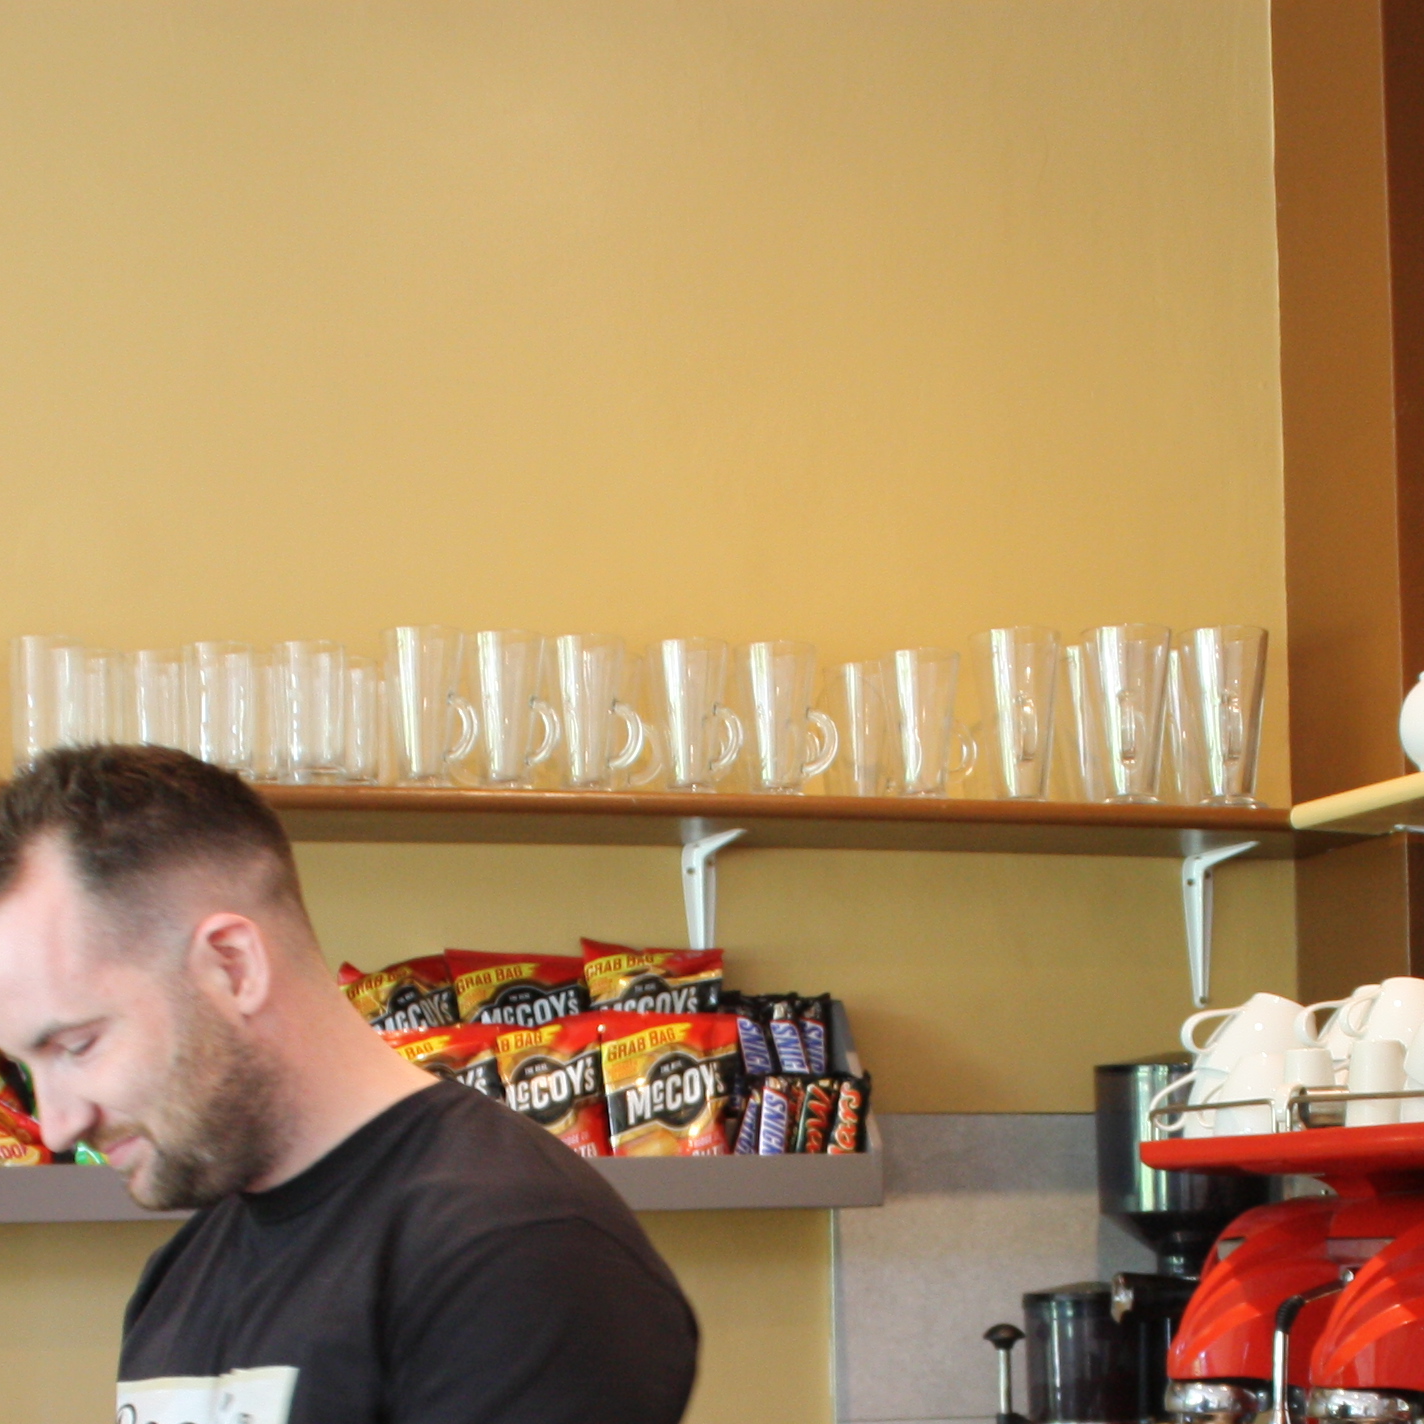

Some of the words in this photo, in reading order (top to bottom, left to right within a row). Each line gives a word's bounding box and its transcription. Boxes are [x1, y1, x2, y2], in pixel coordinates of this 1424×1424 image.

[495, 964, 523, 982] BAG
[514, 1030, 543, 1050] BAG
[607, 1038, 646, 1062] GRAB
[648, 1027, 676, 1046] BAG
